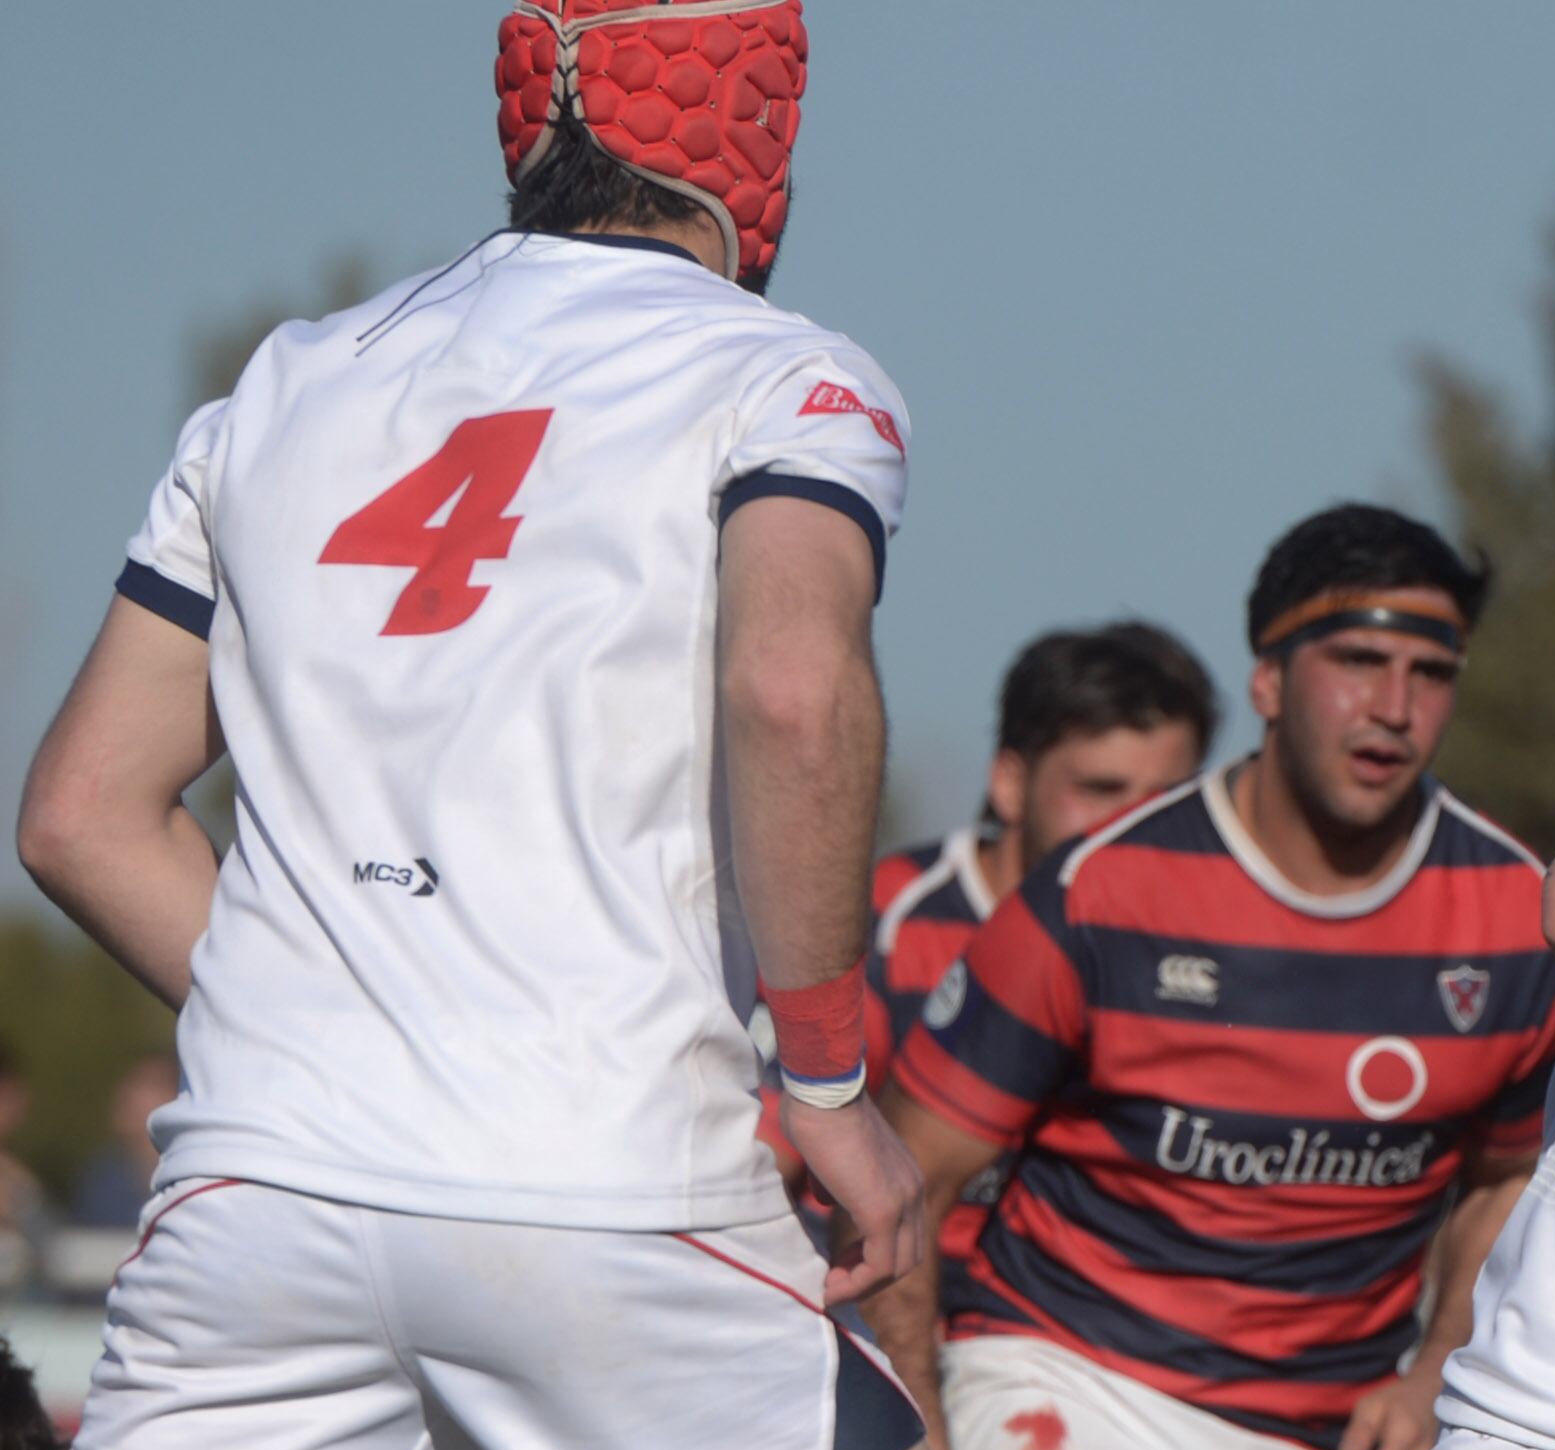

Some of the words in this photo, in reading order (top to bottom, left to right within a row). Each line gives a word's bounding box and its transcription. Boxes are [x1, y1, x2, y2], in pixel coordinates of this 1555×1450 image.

[317, 407, 555, 637] 4
[352, 858, 413, 888] MC3
[1155, 1105, 1430, 1186] Uroclínica
